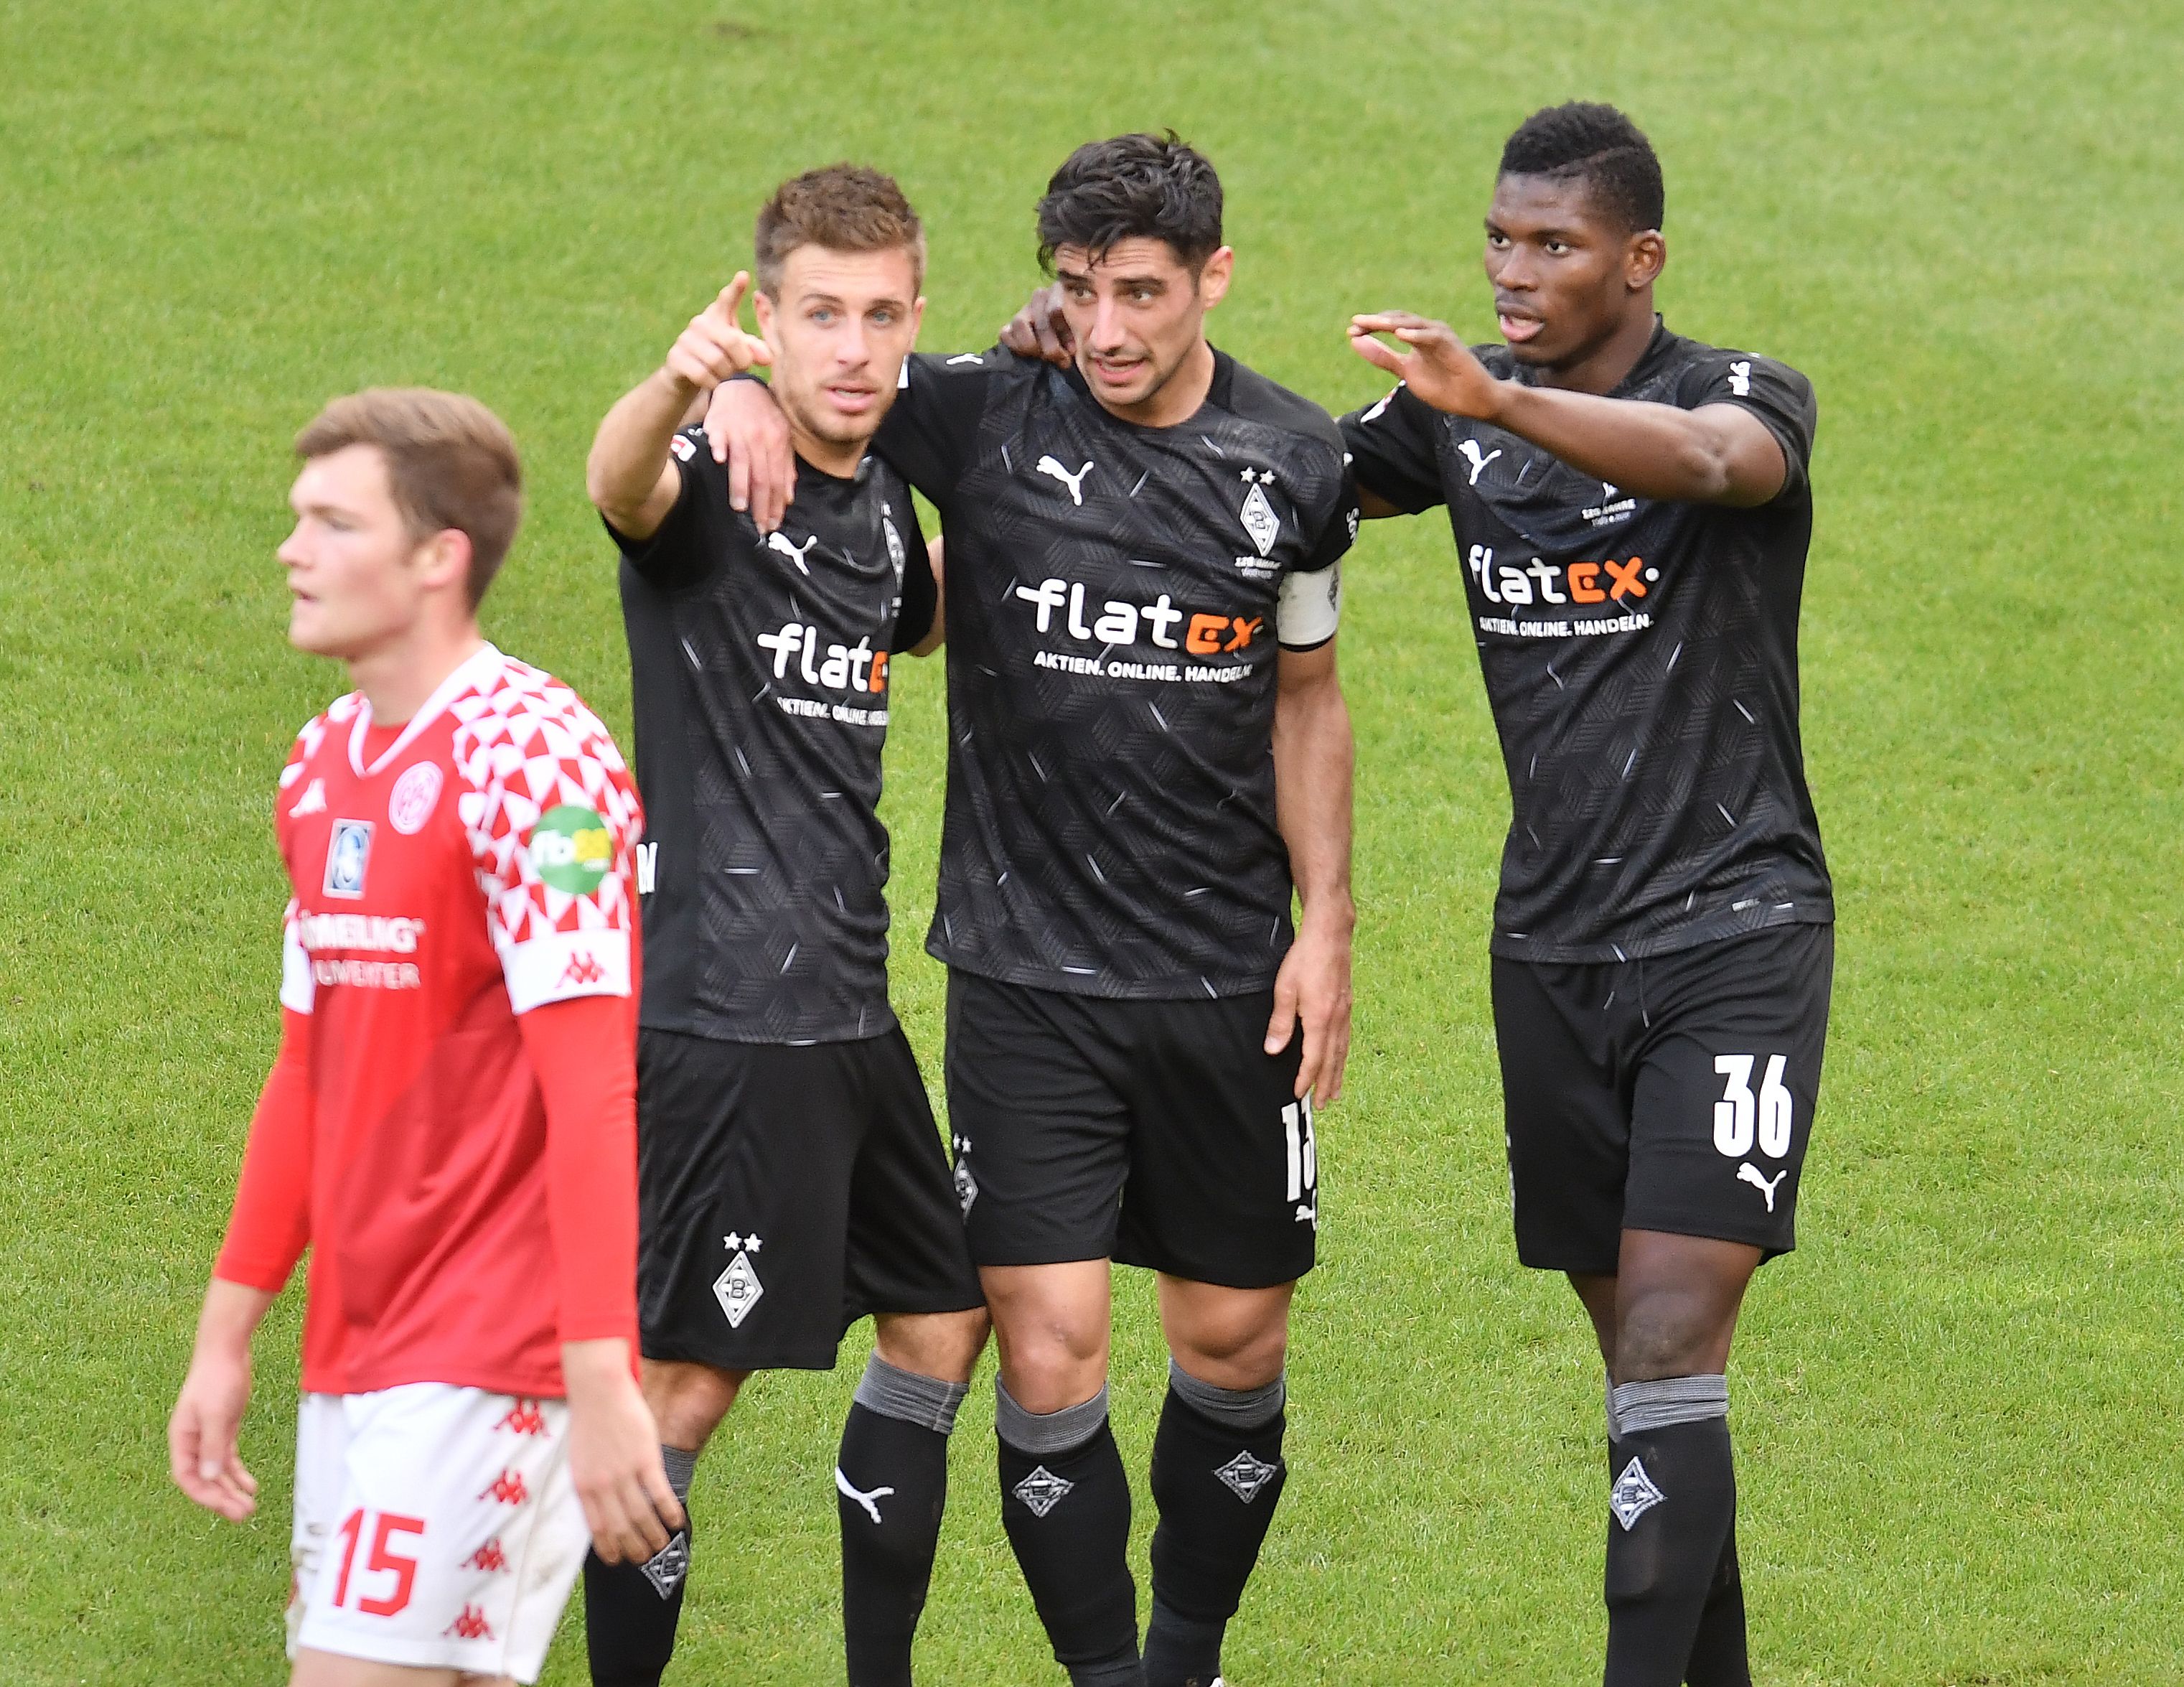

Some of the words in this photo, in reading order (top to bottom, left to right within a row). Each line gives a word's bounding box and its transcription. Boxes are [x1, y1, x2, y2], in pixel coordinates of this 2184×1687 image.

[1016, 578, 1264, 655] flatex
[1034, 650, 1105, 676] AKTIEN.
[1107, 661, 1183, 682] ONLINE.
[1713, 1054, 1793, 1159] 36
[333, 1507, 426, 1617] 15
